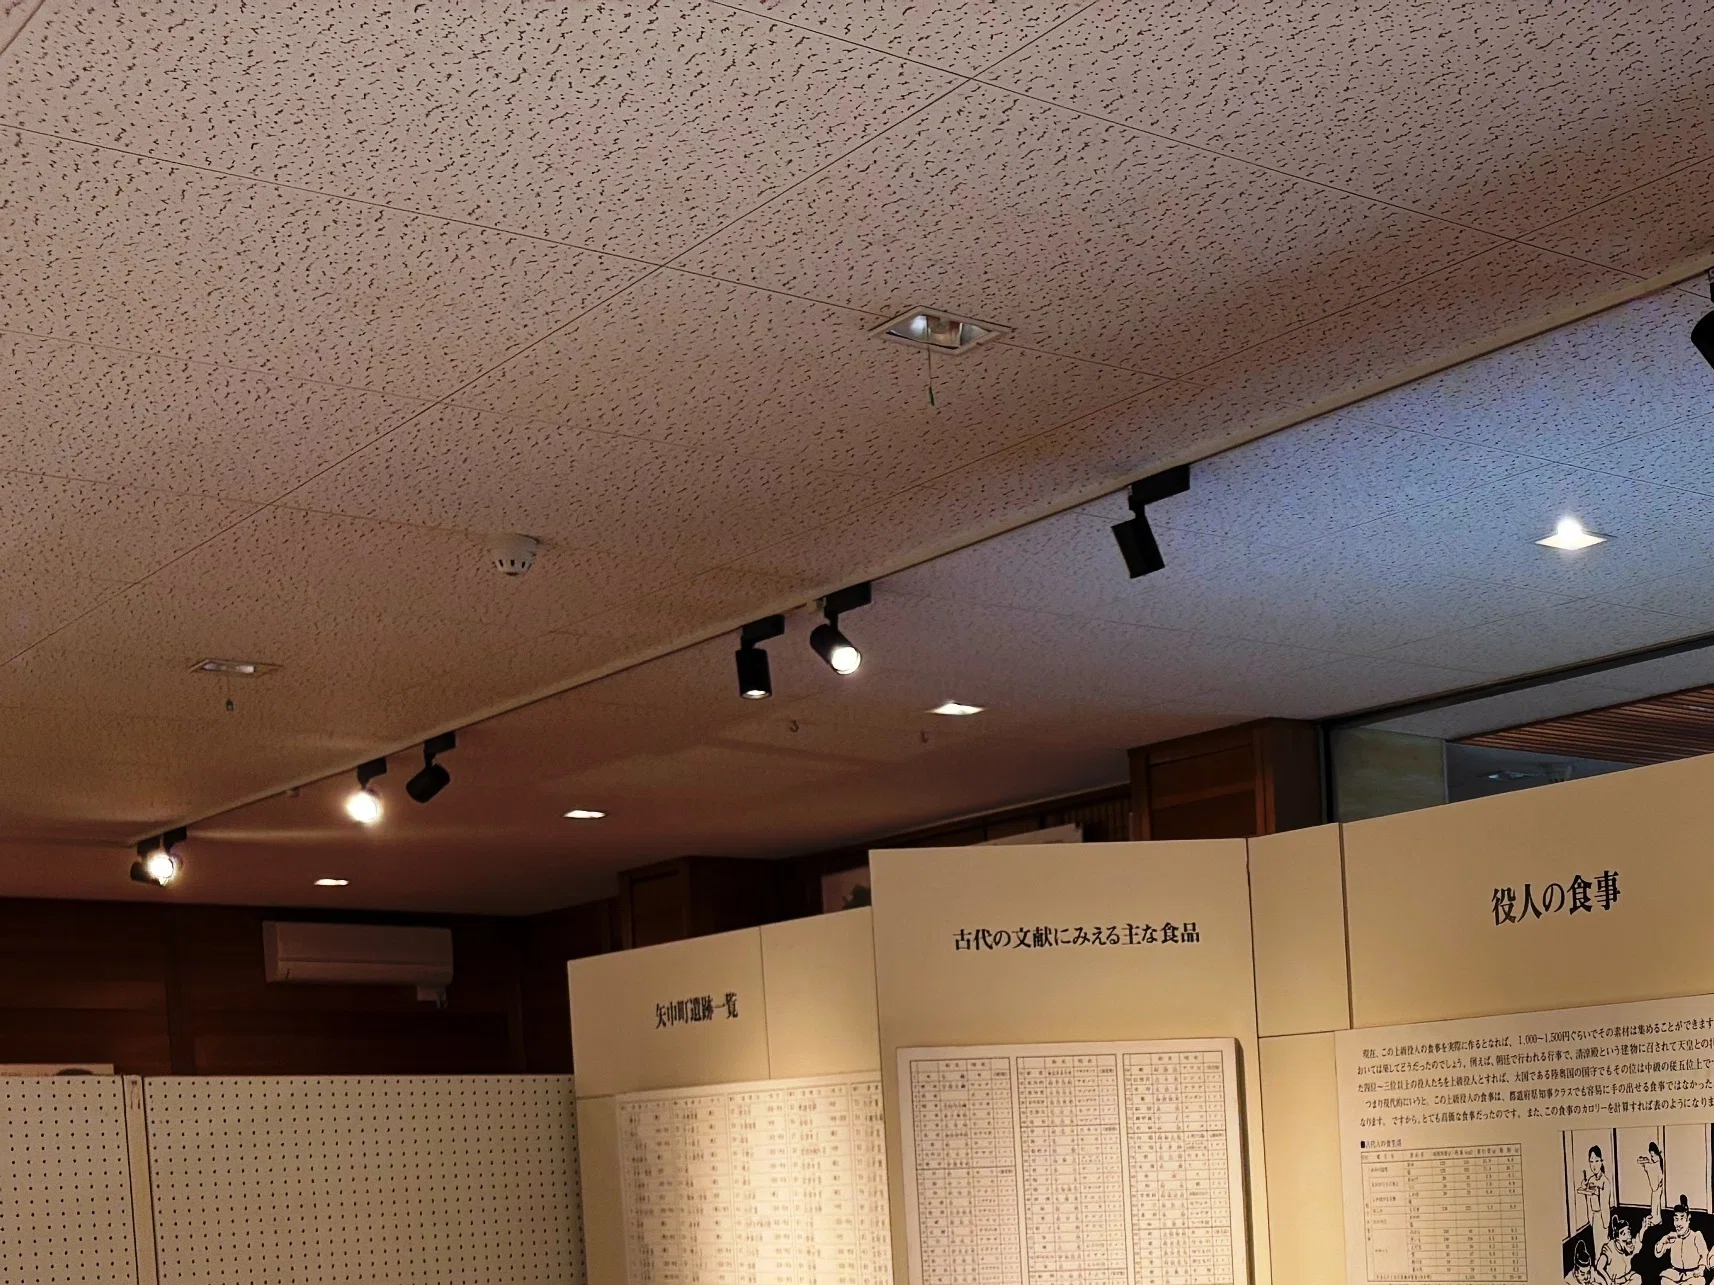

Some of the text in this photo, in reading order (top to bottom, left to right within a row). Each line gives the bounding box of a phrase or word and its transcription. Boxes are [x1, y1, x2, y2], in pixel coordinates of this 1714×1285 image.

[1491, 870, 1621, 926] 役人の食事
[953, 922, 1200, 950] 古代の文献にみえる主な食品
[655, 990, 738, 1029] 矢巾町遺跡一覧
